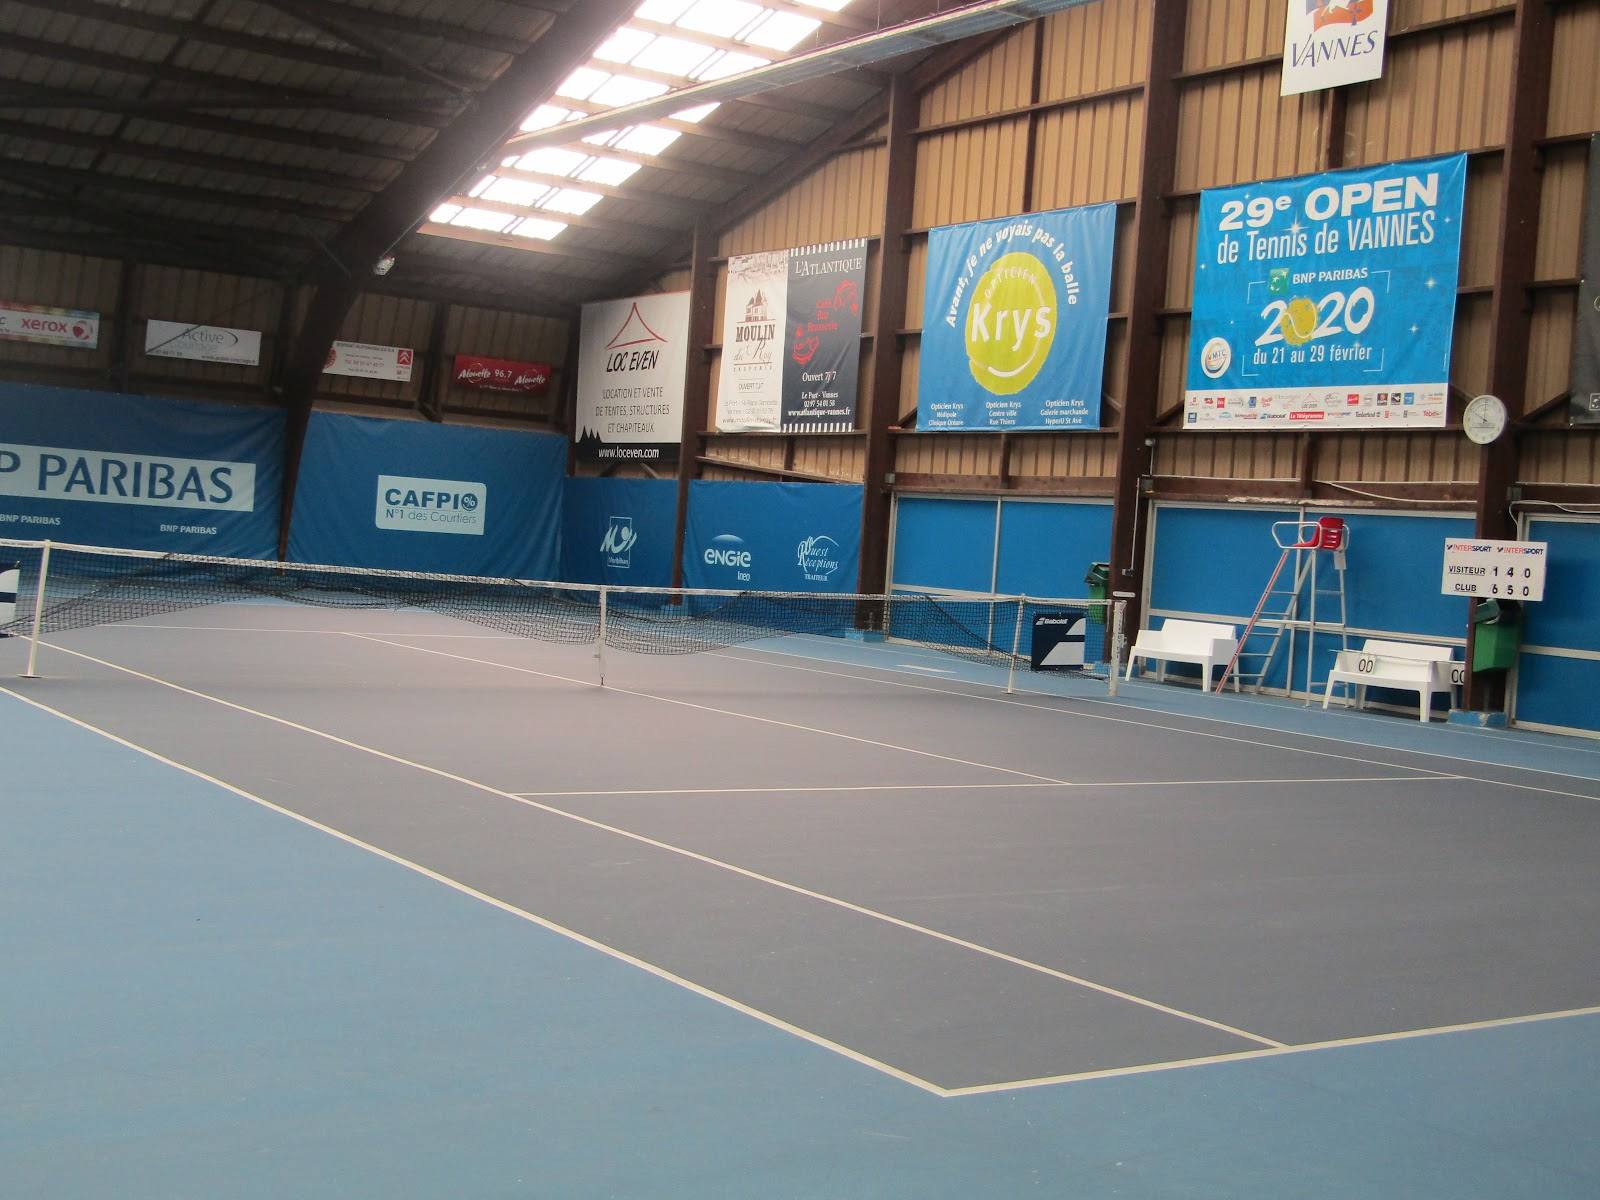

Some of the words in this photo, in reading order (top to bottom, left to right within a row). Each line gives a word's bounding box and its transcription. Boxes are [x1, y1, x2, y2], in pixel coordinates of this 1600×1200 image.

[1292, 30, 1379, 68] VANNES
[1304, 172, 1439, 222] OPEN
[1217, 234, 1239, 264] de
[1246, 228, 1308, 262] Tennis
[1314, 222, 1339, 255] de
[1347, 209, 1437, 251] VANNES
[945, 276, 970, 328] Avant,
[966, 253, 978, 278] je
[979, 236, 993, 258] ne
[995, 219, 1032, 243] voyais
[1031, 226, 1054, 249] pas
[1052, 242, 1065, 263] la
[1060, 260, 1080, 305] balle
[1292, 273, 1316, 285] BNP
[1318, 267, 1369, 282] PARIBAS
[21, 317, 68, 333] xerox
[736, 324, 776, 342] MOULIN
[971, 303, 1051, 352] Krys
[606, 352, 629, 373] LOC
[629, 350, 659, 371] EVEN
[1253, 352, 1267, 365] du
[1271, 349, 1286, 365] 21
[1290, 351, 1304, 363] au
[1310, 346, 1324, 362] 29
[1329, 345, 1372, 362] février
[495, 369, 512, 378] 96.7
[603, 389, 632, 399] LOCATION
[642, 386, 663, 398] VENTE
[629, 404, 670, 416] STRUCTURES
[598, 446, 659, 459] www.loceven.com
[38, 453, 233, 503] PARIBAS
[0, 513, 19, 523] BNP
[21, 515, 61, 526] PARIBAS
[408, 511, 428, 521] des
[430, 511, 477, 524] Courtiers
[160, 524, 179, 533] BNP
[180, 525, 217, 535] PARIBAS
[1453, 544, 1492, 552] INTERSPORT
[1503, 546, 1544, 555] INTERSPORT
[1449, 565, 1486, 575] VISITEUR
[1524, 568, 1531, 578] 0
[1455, 583, 1477, 592] CLUB
[1523, 586, 1529, 596] 0
